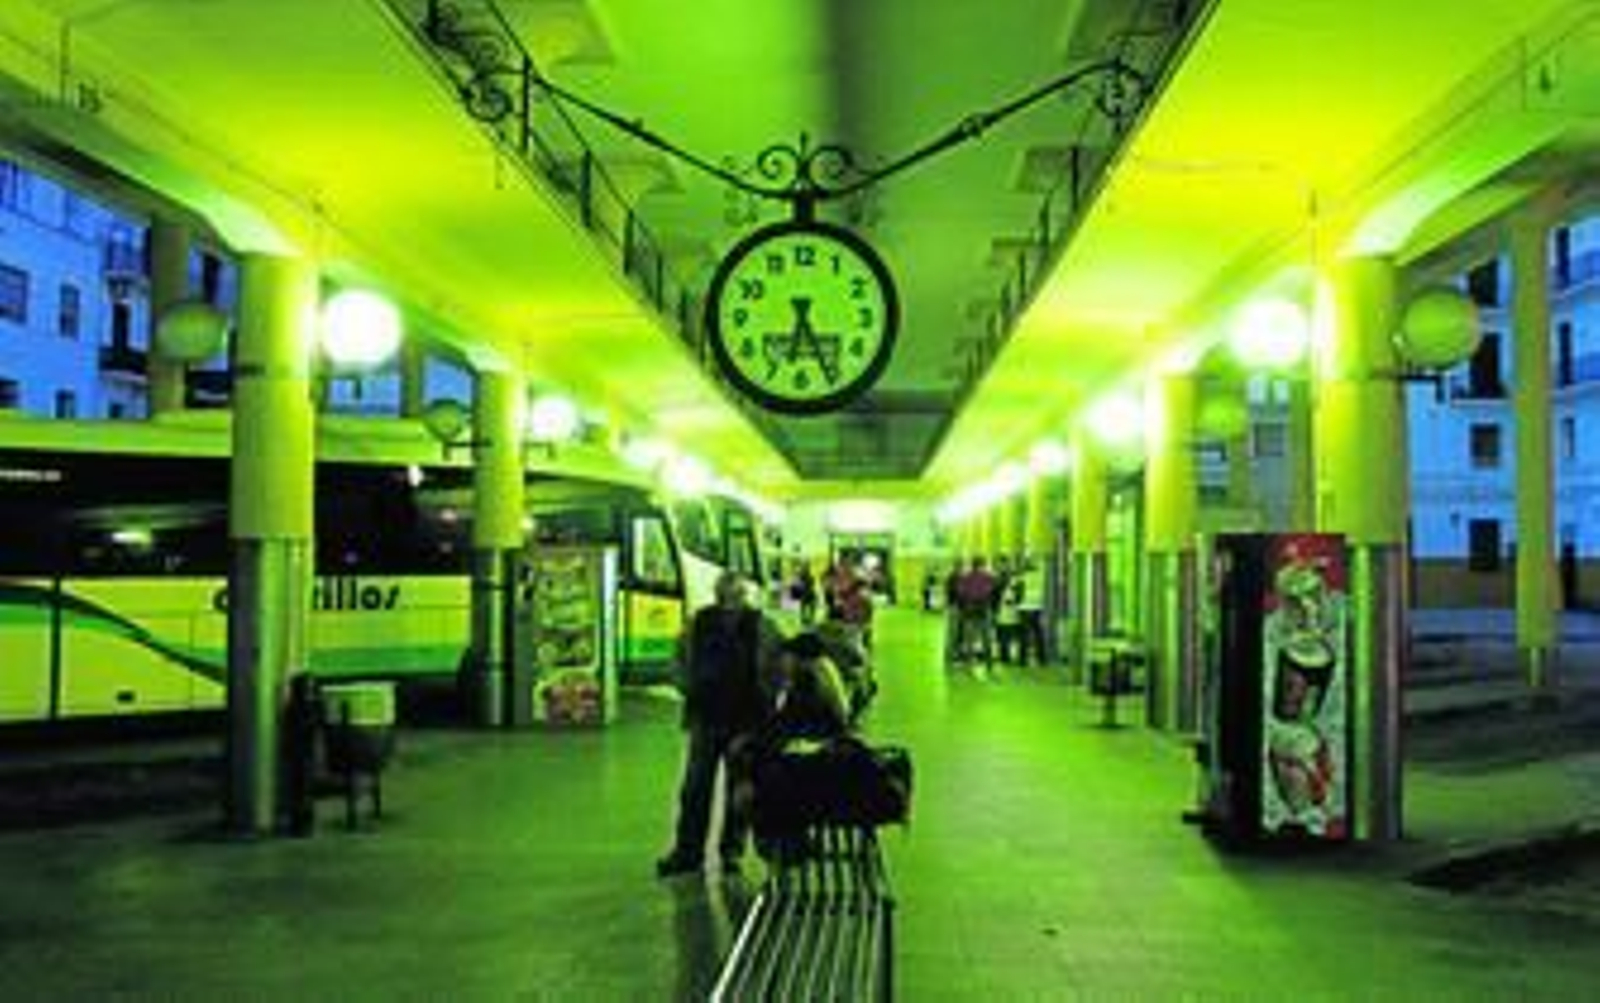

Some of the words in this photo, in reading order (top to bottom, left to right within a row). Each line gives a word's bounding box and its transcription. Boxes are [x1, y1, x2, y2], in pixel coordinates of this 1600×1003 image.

[767, 254, 785, 275] 11
[796, 245, 816, 266] 12
[739, 279, 764, 300] 10
[850, 277, 867, 299] 2
[734, 308, 748, 328] 9
[859, 307, 873, 329] 3
[742, 337, 755, 358] 8
[849, 336, 863, 358] 4
[766, 360, 779, 382] 7
[794, 369, 810, 390] 6
